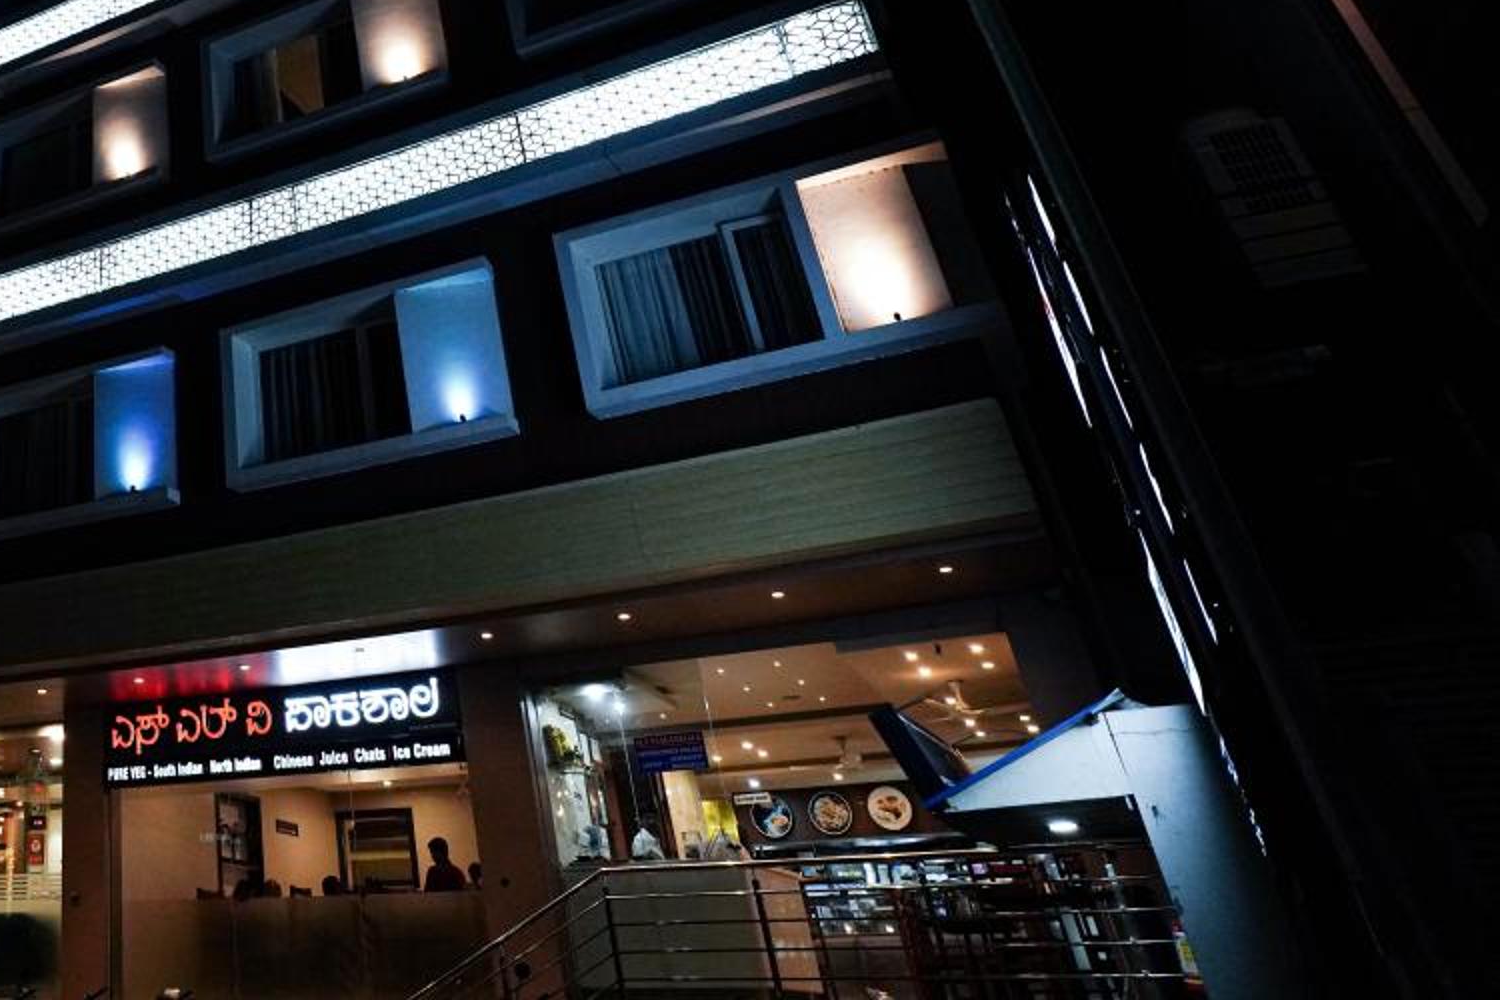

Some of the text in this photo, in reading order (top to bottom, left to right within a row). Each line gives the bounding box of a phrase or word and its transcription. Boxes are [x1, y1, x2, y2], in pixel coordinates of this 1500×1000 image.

[111, 705, 170, 755] ಎಸ್
[176, 698, 237, 743] ಎಲ್
[246, 700, 272, 736] ವಿ
[107, 767, 129, 781] PURE
[130, 765, 147, 779] VEG
[153, 764, 177, 778] South
[177, 761, 204, 776] Indian
[209, 758, 233, 774] North
[234, 756, 262, 771] Indian
[273, 754, 315, 770] Chinese
[319, 751, 349, 766] Juice
[354, 746, 387, 763] Chats
[392, 744, 411, 760] Ice
[413, 742, 451, 758] Cream
